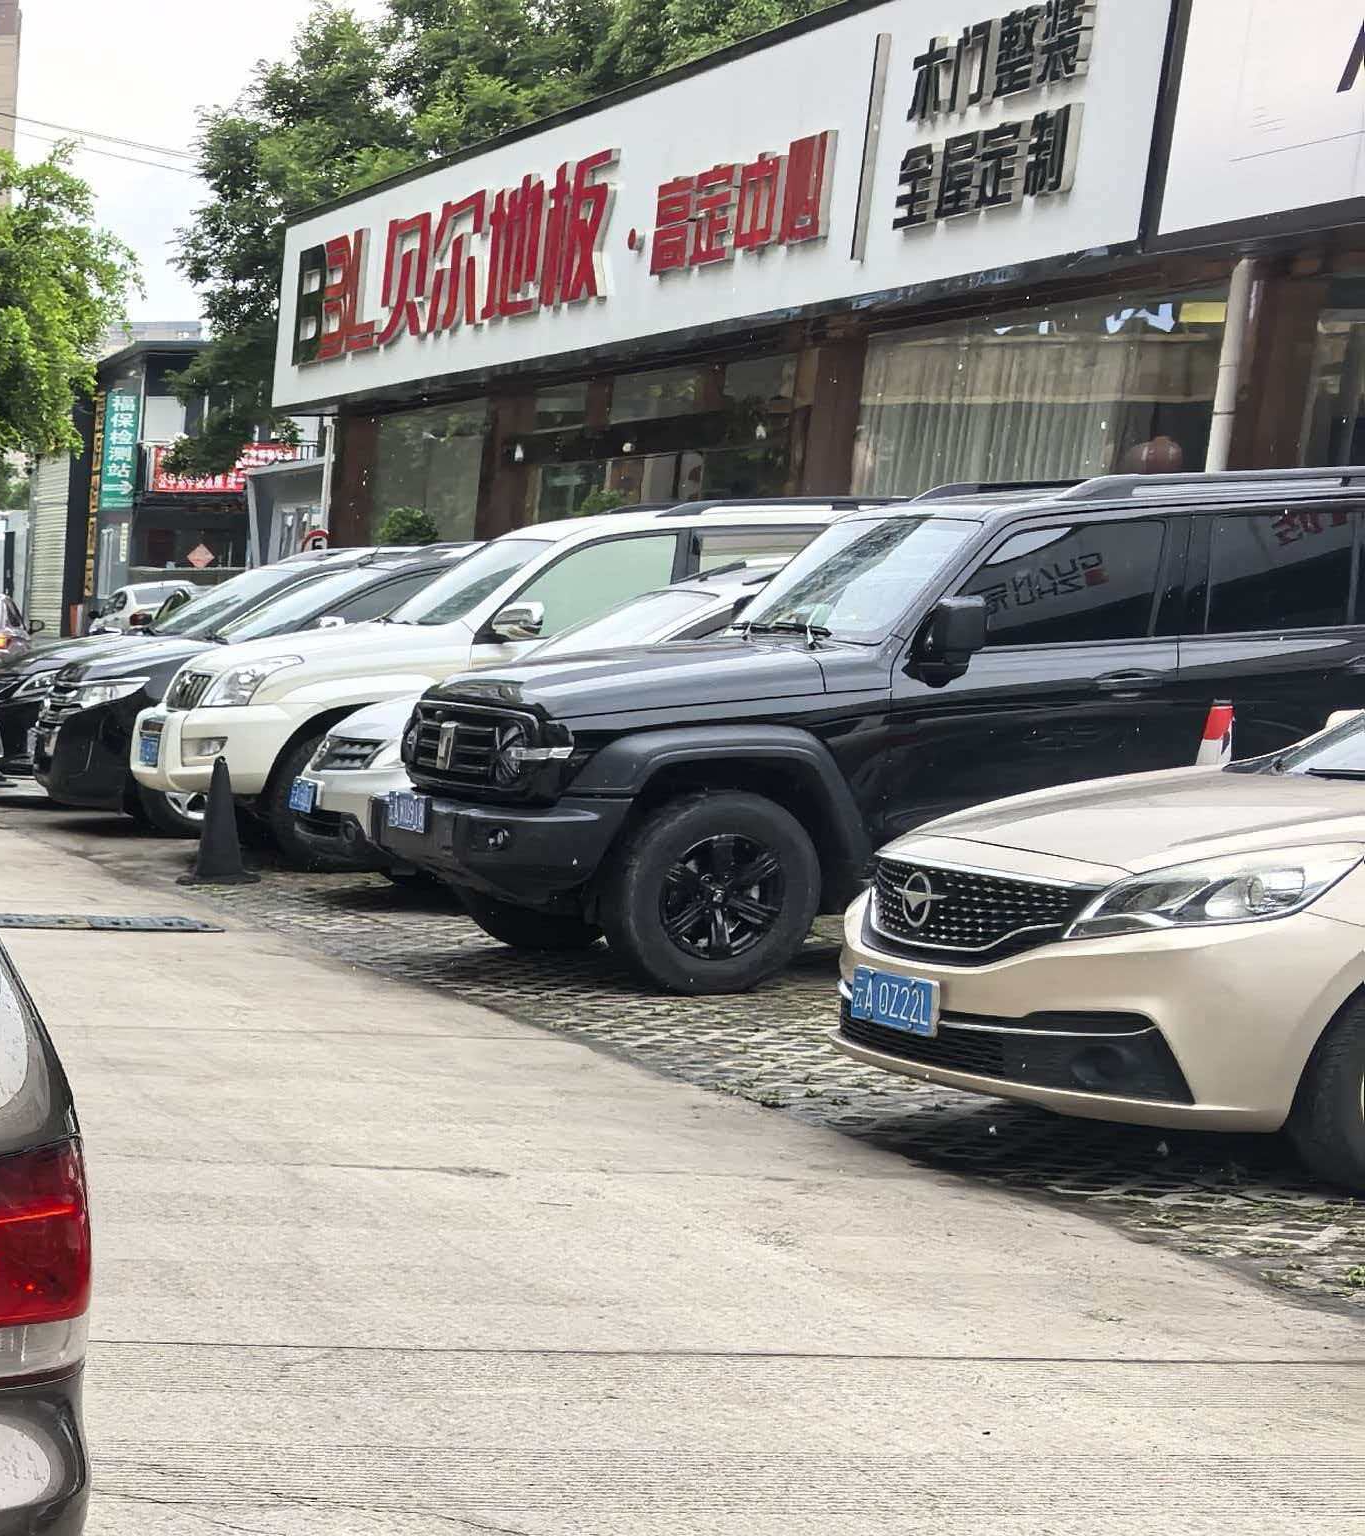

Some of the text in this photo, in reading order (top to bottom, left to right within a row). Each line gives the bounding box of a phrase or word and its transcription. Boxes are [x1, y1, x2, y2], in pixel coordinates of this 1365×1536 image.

[892, 104, 1083, 231] 全屋定制
[377, 147, 621, 346] 贝尔地板
[106, 394, 137, 478] 福保检测站
